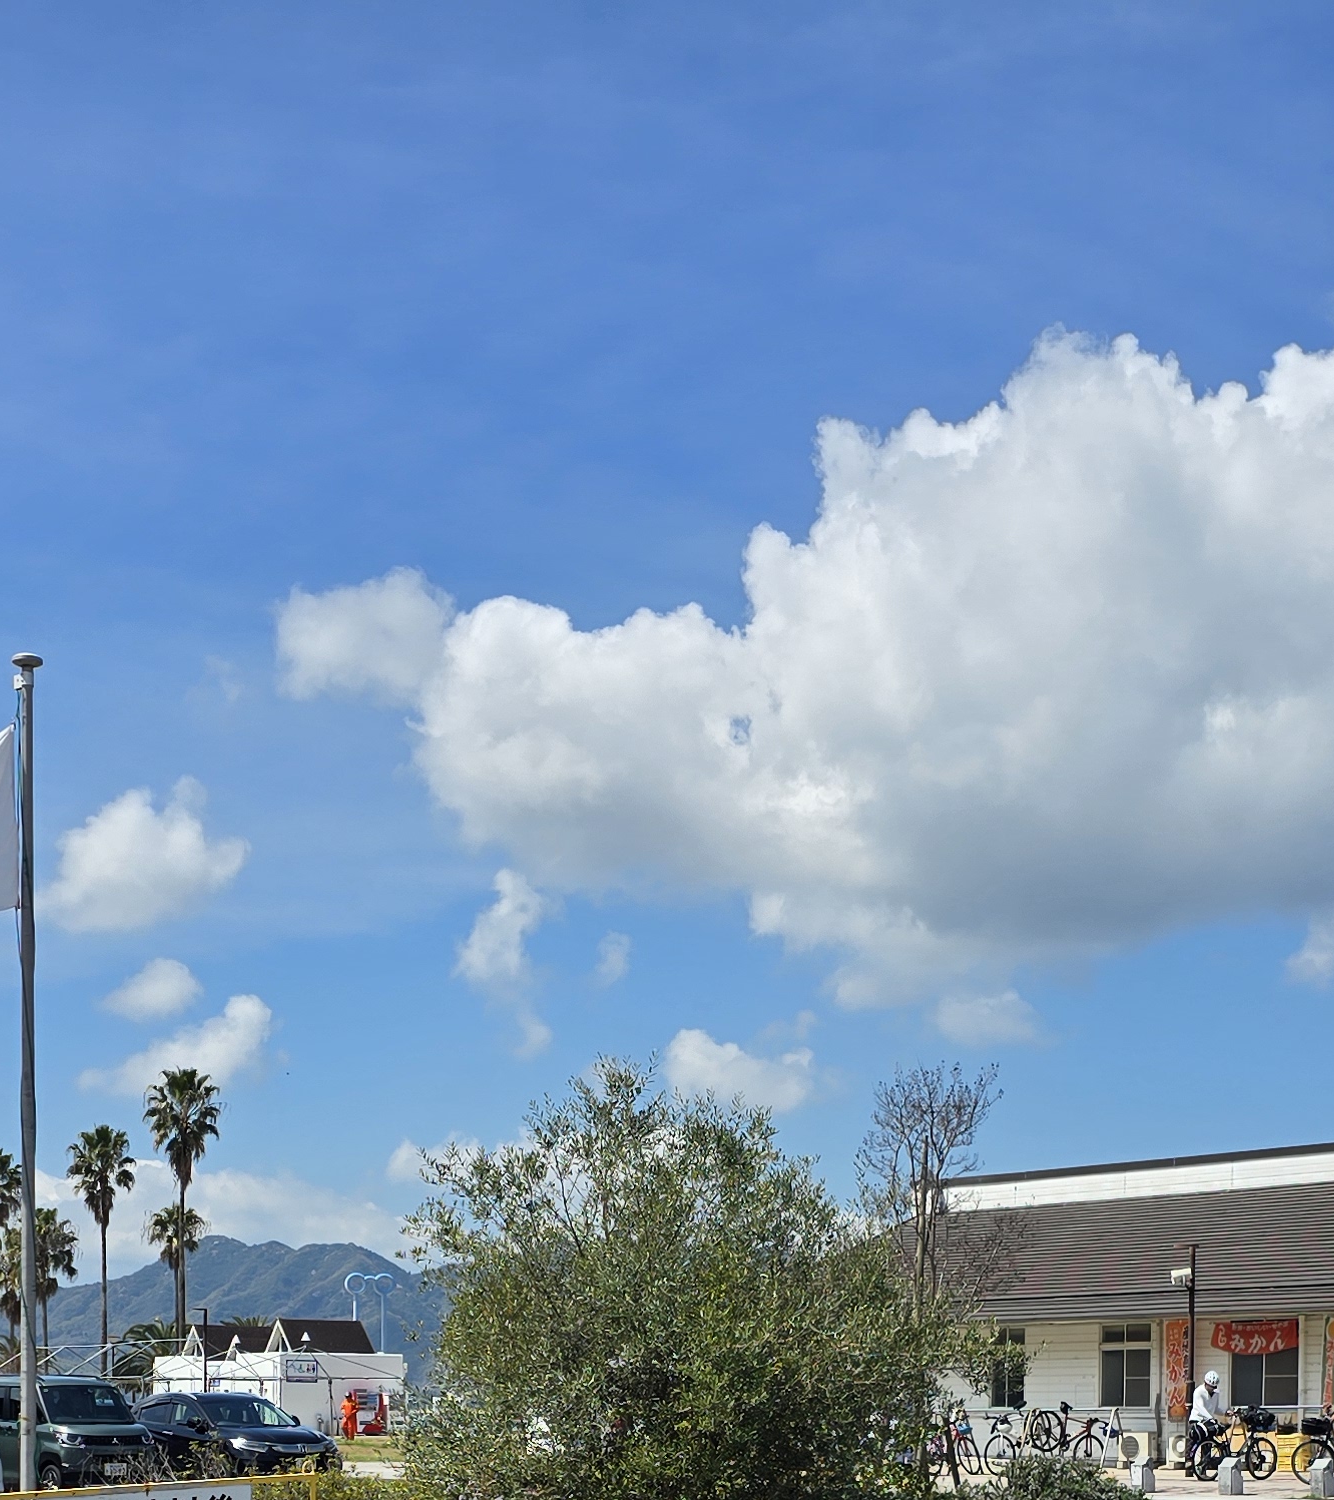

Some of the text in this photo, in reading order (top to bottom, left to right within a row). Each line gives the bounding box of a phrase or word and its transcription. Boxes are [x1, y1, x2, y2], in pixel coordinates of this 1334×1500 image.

[1229, 1331, 1286, 1353] みかん
[1168, 1341, 1187, 1407] みかん
